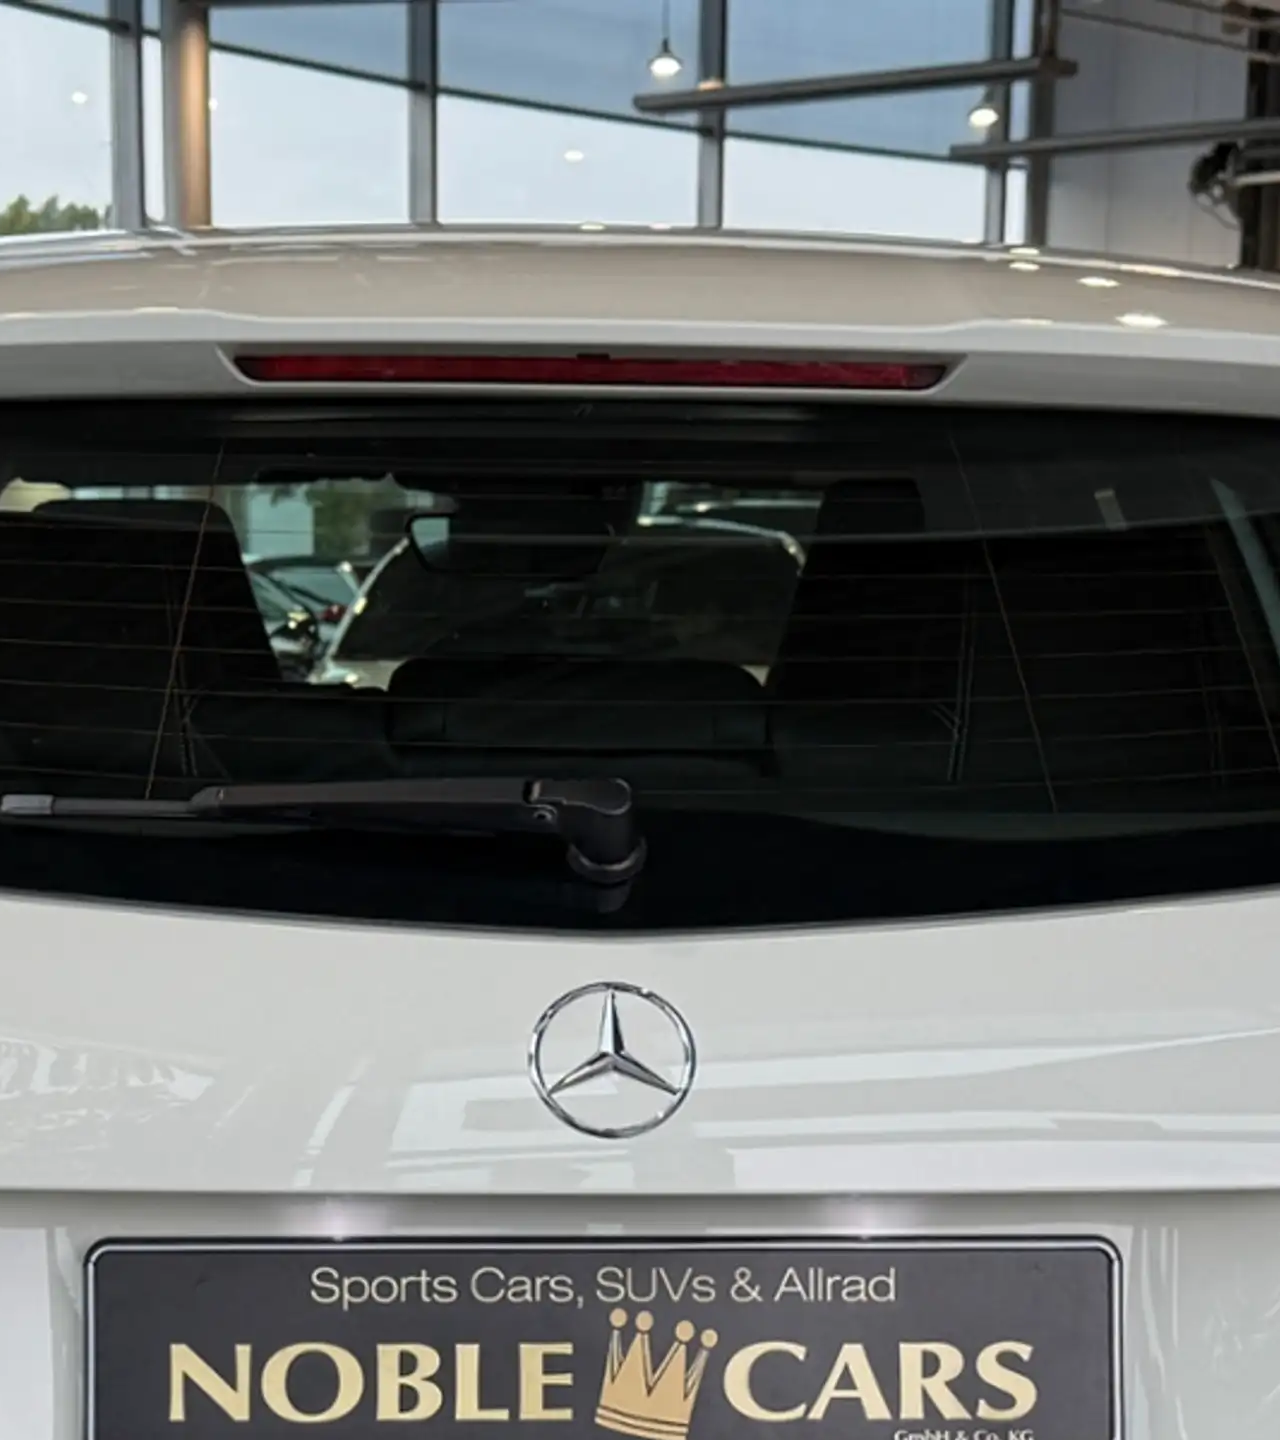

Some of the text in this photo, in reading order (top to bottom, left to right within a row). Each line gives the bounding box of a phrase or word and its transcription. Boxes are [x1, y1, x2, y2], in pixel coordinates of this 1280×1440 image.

[310, 1266, 897, 1311] Sports Cars, SUVs & Allrad
[168, 1340, 1038, 1424] NOBLE CARS
